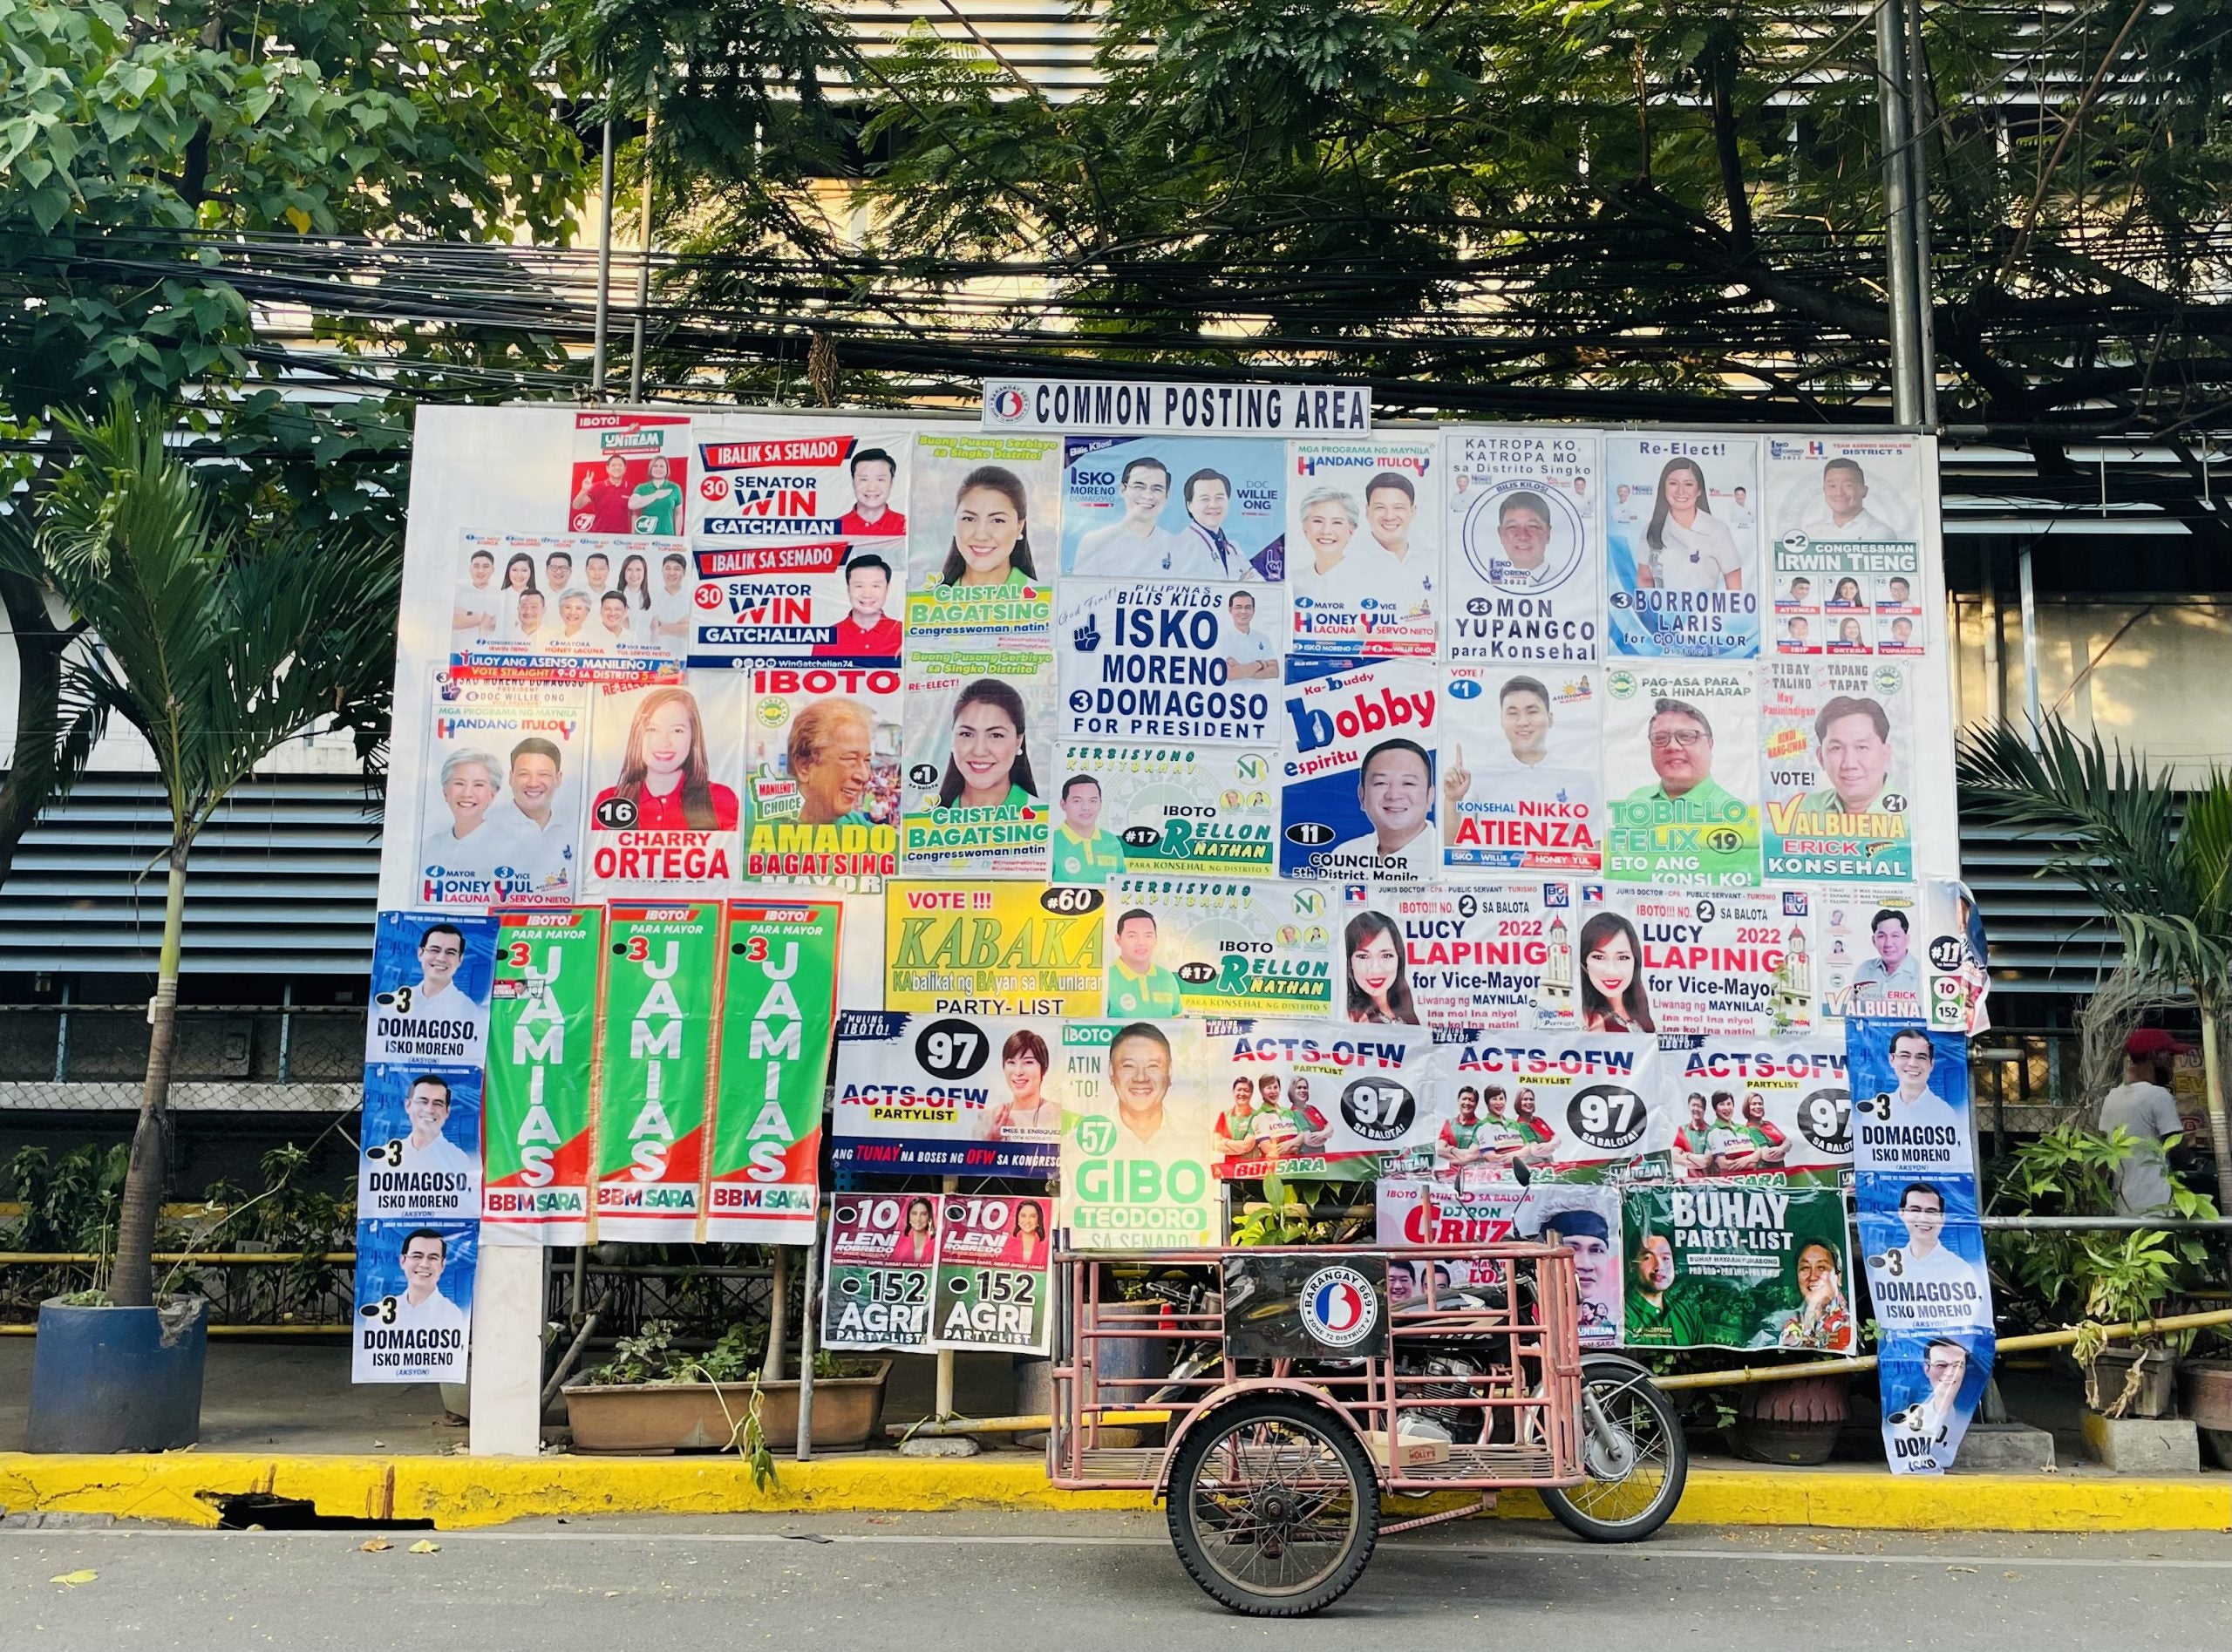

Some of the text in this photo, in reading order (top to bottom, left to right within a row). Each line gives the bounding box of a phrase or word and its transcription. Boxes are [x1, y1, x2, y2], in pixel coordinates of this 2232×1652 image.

[1036, 384, 1364, 430] COMMON POSTING AREA
[580, 417, 620, 426] IBOTO!
[718, 441, 838, 464] IBALIK SA SENADO
[1466, 452, 1576, 463] KATROPA MO
[1640, 442, 1725, 456] Re-Elect!
[1071, 467, 1115, 486] ISKO
[1477, 464, 1533, 473] Distrito
[1541, 465, 1590, 476] Singko
[735, 476, 816, 488] SENATOR
[703, 481, 816, 516] 30 WIN
[1236, 489, 1278, 500] WILLIE
[1243, 500, 1271, 510] ONG
[711, 520, 834, 534] GATCHALIAN
[1778, 553, 1916, 571] IRWIN TIENG
[935, 586, 1020, 602] CRISTAL
[1135, 584, 1210, 594] PILIPINAS
[1117, 592, 1222, 608] BILIS KILOS
[1469, 599, 1552, 617] 23 MON
[1616, 590, 1756, 613] 3 BORROMEO
[911, 603, 1050, 623] BAGATSING
[910, 622, 1049, 636] Congresswoman natin!
[1115, 608, 1219, 650] ISKO
[1455, 619, 1595, 641] YUPANGCO
[1658, 615, 1722, 631] LARIS
[1624, 634, 1745, 646] for COUNCILOR
[1452, 641, 1596, 660] para Konsehal
[1103, 655, 1228, 686] MORENO
[1772, 664, 1868, 676] TIBAY TAPANG
[755, 670, 901, 694] IBOTO
[908, 679, 959, 690] RE-ELECT!
[1304, 673, 1375, 696] Ka-buddy
[1642, 677, 1739, 686] PAG-ASA PARA
[1773, 679, 1868, 690] TALINO TAPAT
[506, 693, 540, 702] WILLIE
[1650, 687, 1751, 697] SA HINAHARAP
[1777, 693, 1793, 704] May
[1074, 689, 1269, 720] 3 DOMAGOSO
[1073, 718, 1265, 738] FOR PRESIDENT
[1285, 688, 1435, 753] bobby
[1067, 747, 1195, 762] SERBISYONG
[1284, 750, 1358, 777] espiritu
[913, 766, 931, 783] #1
[1066, 760, 1196, 774] KAPITBAHAY
[1771, 772, 1814, 786] VOTE!
[600, 804, 632, 821] 16
[764, 798, 800, 815] CHOICE
[1163, 806, 1216, 817] IBOTO
[1457, 801, 1589, 818] KONSEHAL NIKKO
[1887, 796, 1903, 811] 21
[1607, 800, 1755, 827] TOBILLO,
[1766, 792, 1906, 839] VALBUENA
[618, 833, 711, 846] CHARRY
[750, 824, 896, 853] AMADO
[1301, 825, 1319, 843] 11
[1455, 818, 1594, 847] ATIENZA
[1608, 828, 1701, 852] FELIX
[1712, 833, 1738, 849] 19
[1194, 842, 1266, 858] NATHAN
[1784, 840, 1858, 855] ERICK
[594, 847, 729, 880] ORTEGA
[749, 853, 895, 875] BAGATSING
[1310, 853, 1407, 869] COUNCILOR
[1611, 857, 1699, 871] ETO ANG
[1767, 858, 1907, 876] KONSEHAL
[908, 893, 965, 909] VOTE
[1047, 888, 1092, 910] #60
[645, 909, 690, 921] IBOTO!
[630, 925, 703, 934] PARA MAYOR
[1406, 921, 1542, 938] LUCY 2022
[892, 917, 1103, 969] KABAKA
[1931, 942, 1961, 962] #11
[1407, 942, 1548, 965] LAPINIG
[1412, 972, 1541, 992] for Vice-Mayor
[1940, 983, 1955, 993] 10
[396, 987, 412, 1013] 3
[847, 1015, 883, 1024] MULING
[1938, 1007, 1958, 1017] 152
[378, 1018, 477, 1043] DOMAGOSO,
[844, 1019, 889, 1036] IBOTO!
[927, 1032, 978, 1070] 97
[628, 941, 684, 1181] JAMIAS
[1068, 1057, 1101, 1073] ATIN
[1458, 1047, 1634, 1075] ACTS-OFW
[1520, 1076, 1571, 1084] PARTYLIST
[840, 1084, 990, 1110] ACTS-OFW
[874, 1109, 955, 1120] PARTYLIST
[1580, 1094, 1634, 1133] 97
[1081, 1121, 1113, 1152] 57
[1862, 1126, 1961, 1146] DOMAGOSO,
[1872, 1148, 1950, 1161] ISKO MORENO
[1076, 1159, 1206, 1204] GIBO
[596, 1188, 695, 1207] BBM SARA
[857, 1199, 900, 1229] 10
[1080, 1207, 1200, 1229] TEODORO
[1671, 1192, 1789, 1229] BUHAY
[1675, 1229, 1794, 1250] PARTY-LIST
[834, 1244, 895, 1254] ROBREDO
[867, 1269, 927, 1303] 152
[1305, 1271, 1372, 1308] BARANGAY 669
[837, 1302, 924, 1333] AGRI
[836, 1330, 922, 1343] PARTY-LIST
[1309, 1318, 1324, 1335] ZONE
[1336, 1324, 1367, 1341] DISTRICT
[364, 1329, 464, 1350] DOMAGOSO,
